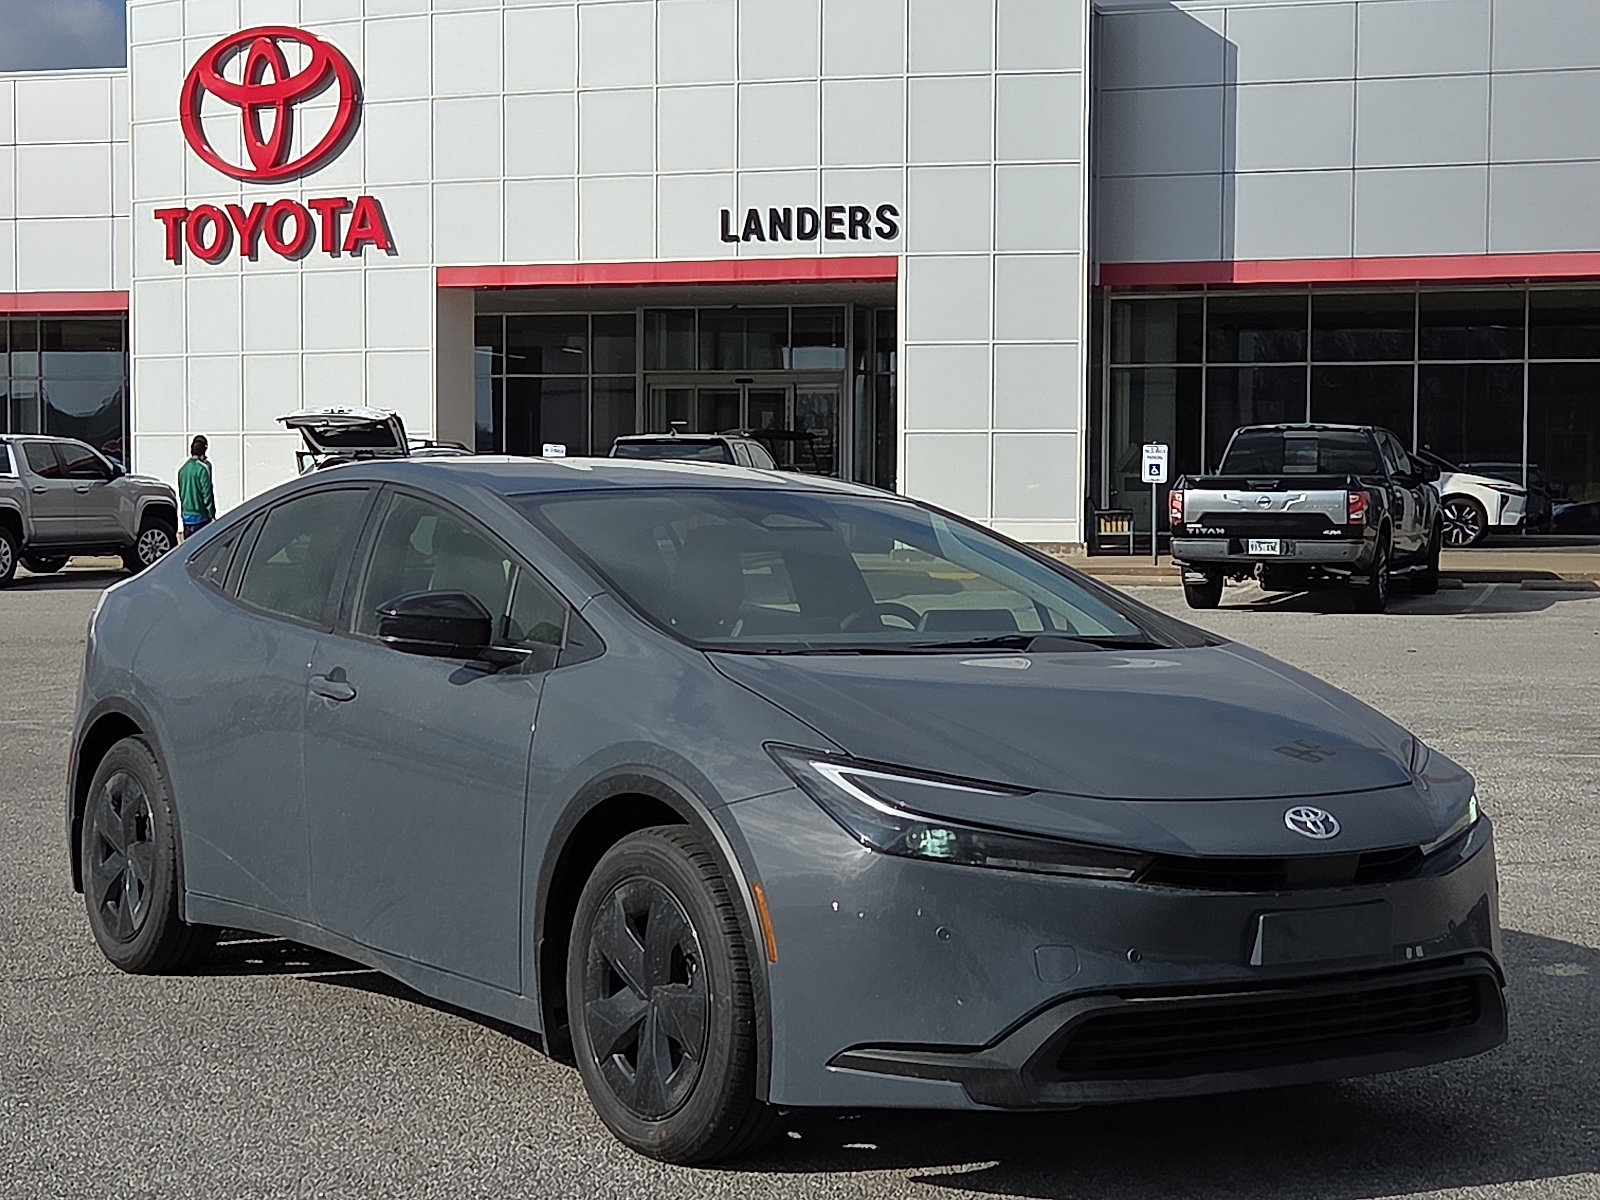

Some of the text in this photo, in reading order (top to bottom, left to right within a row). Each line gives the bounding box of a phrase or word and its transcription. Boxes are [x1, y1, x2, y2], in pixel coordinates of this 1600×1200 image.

[154, 195, 396, 264] TOYOTA
[720, 204, 900, 243] LANDERS
[1186, 527, 1225, 535] TITAN
